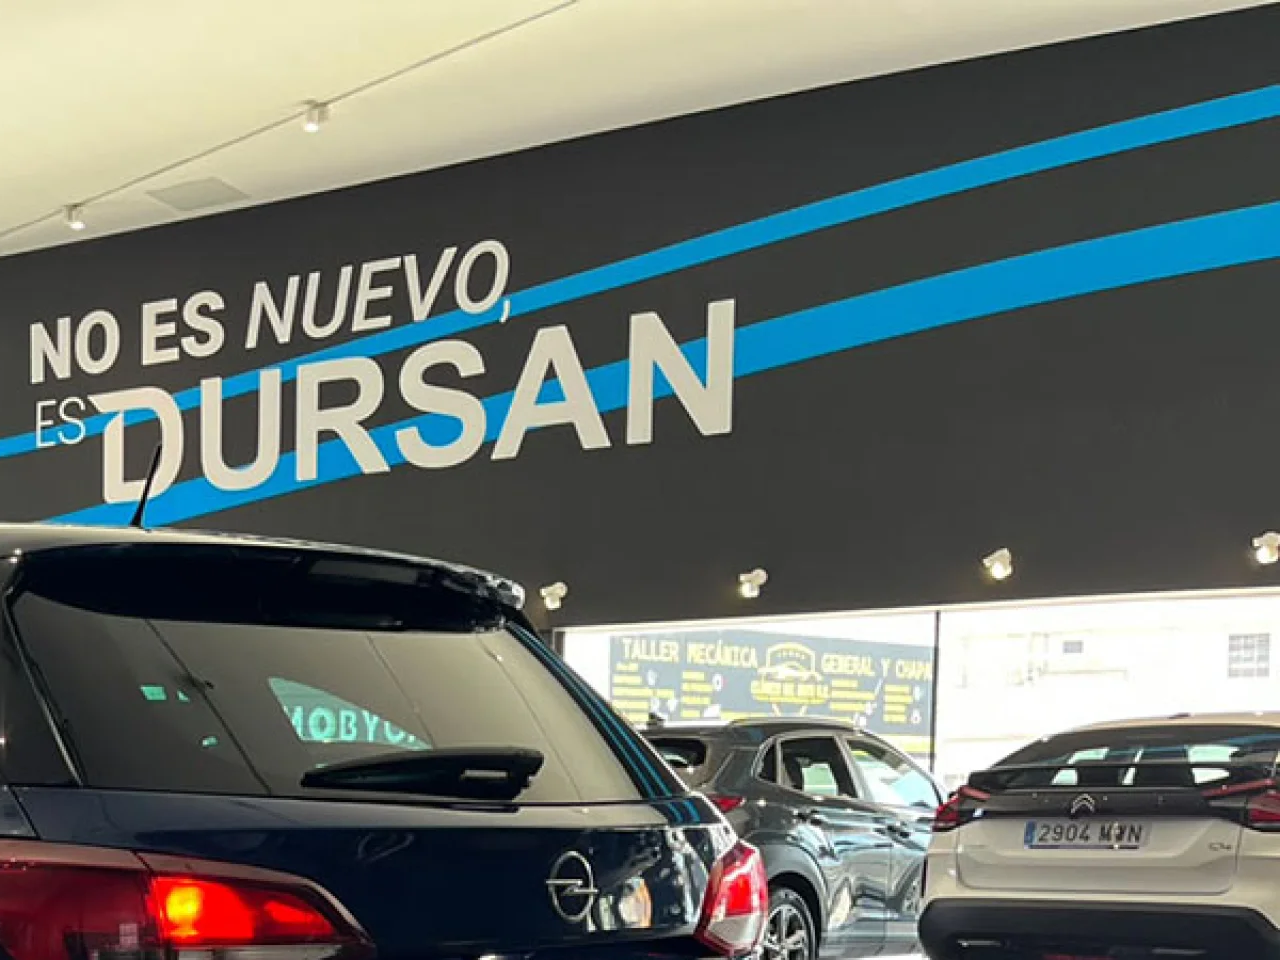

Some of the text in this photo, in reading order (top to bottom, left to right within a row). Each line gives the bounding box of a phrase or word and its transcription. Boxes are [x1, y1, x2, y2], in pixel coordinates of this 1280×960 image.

[29, 240, 511, 384] NO ES NUEVO,
[35, 298, 736, 504] ES DURSAN
[622, 637, 680, 664] TALLER
[1037, 822, 1091, 843] 2904
